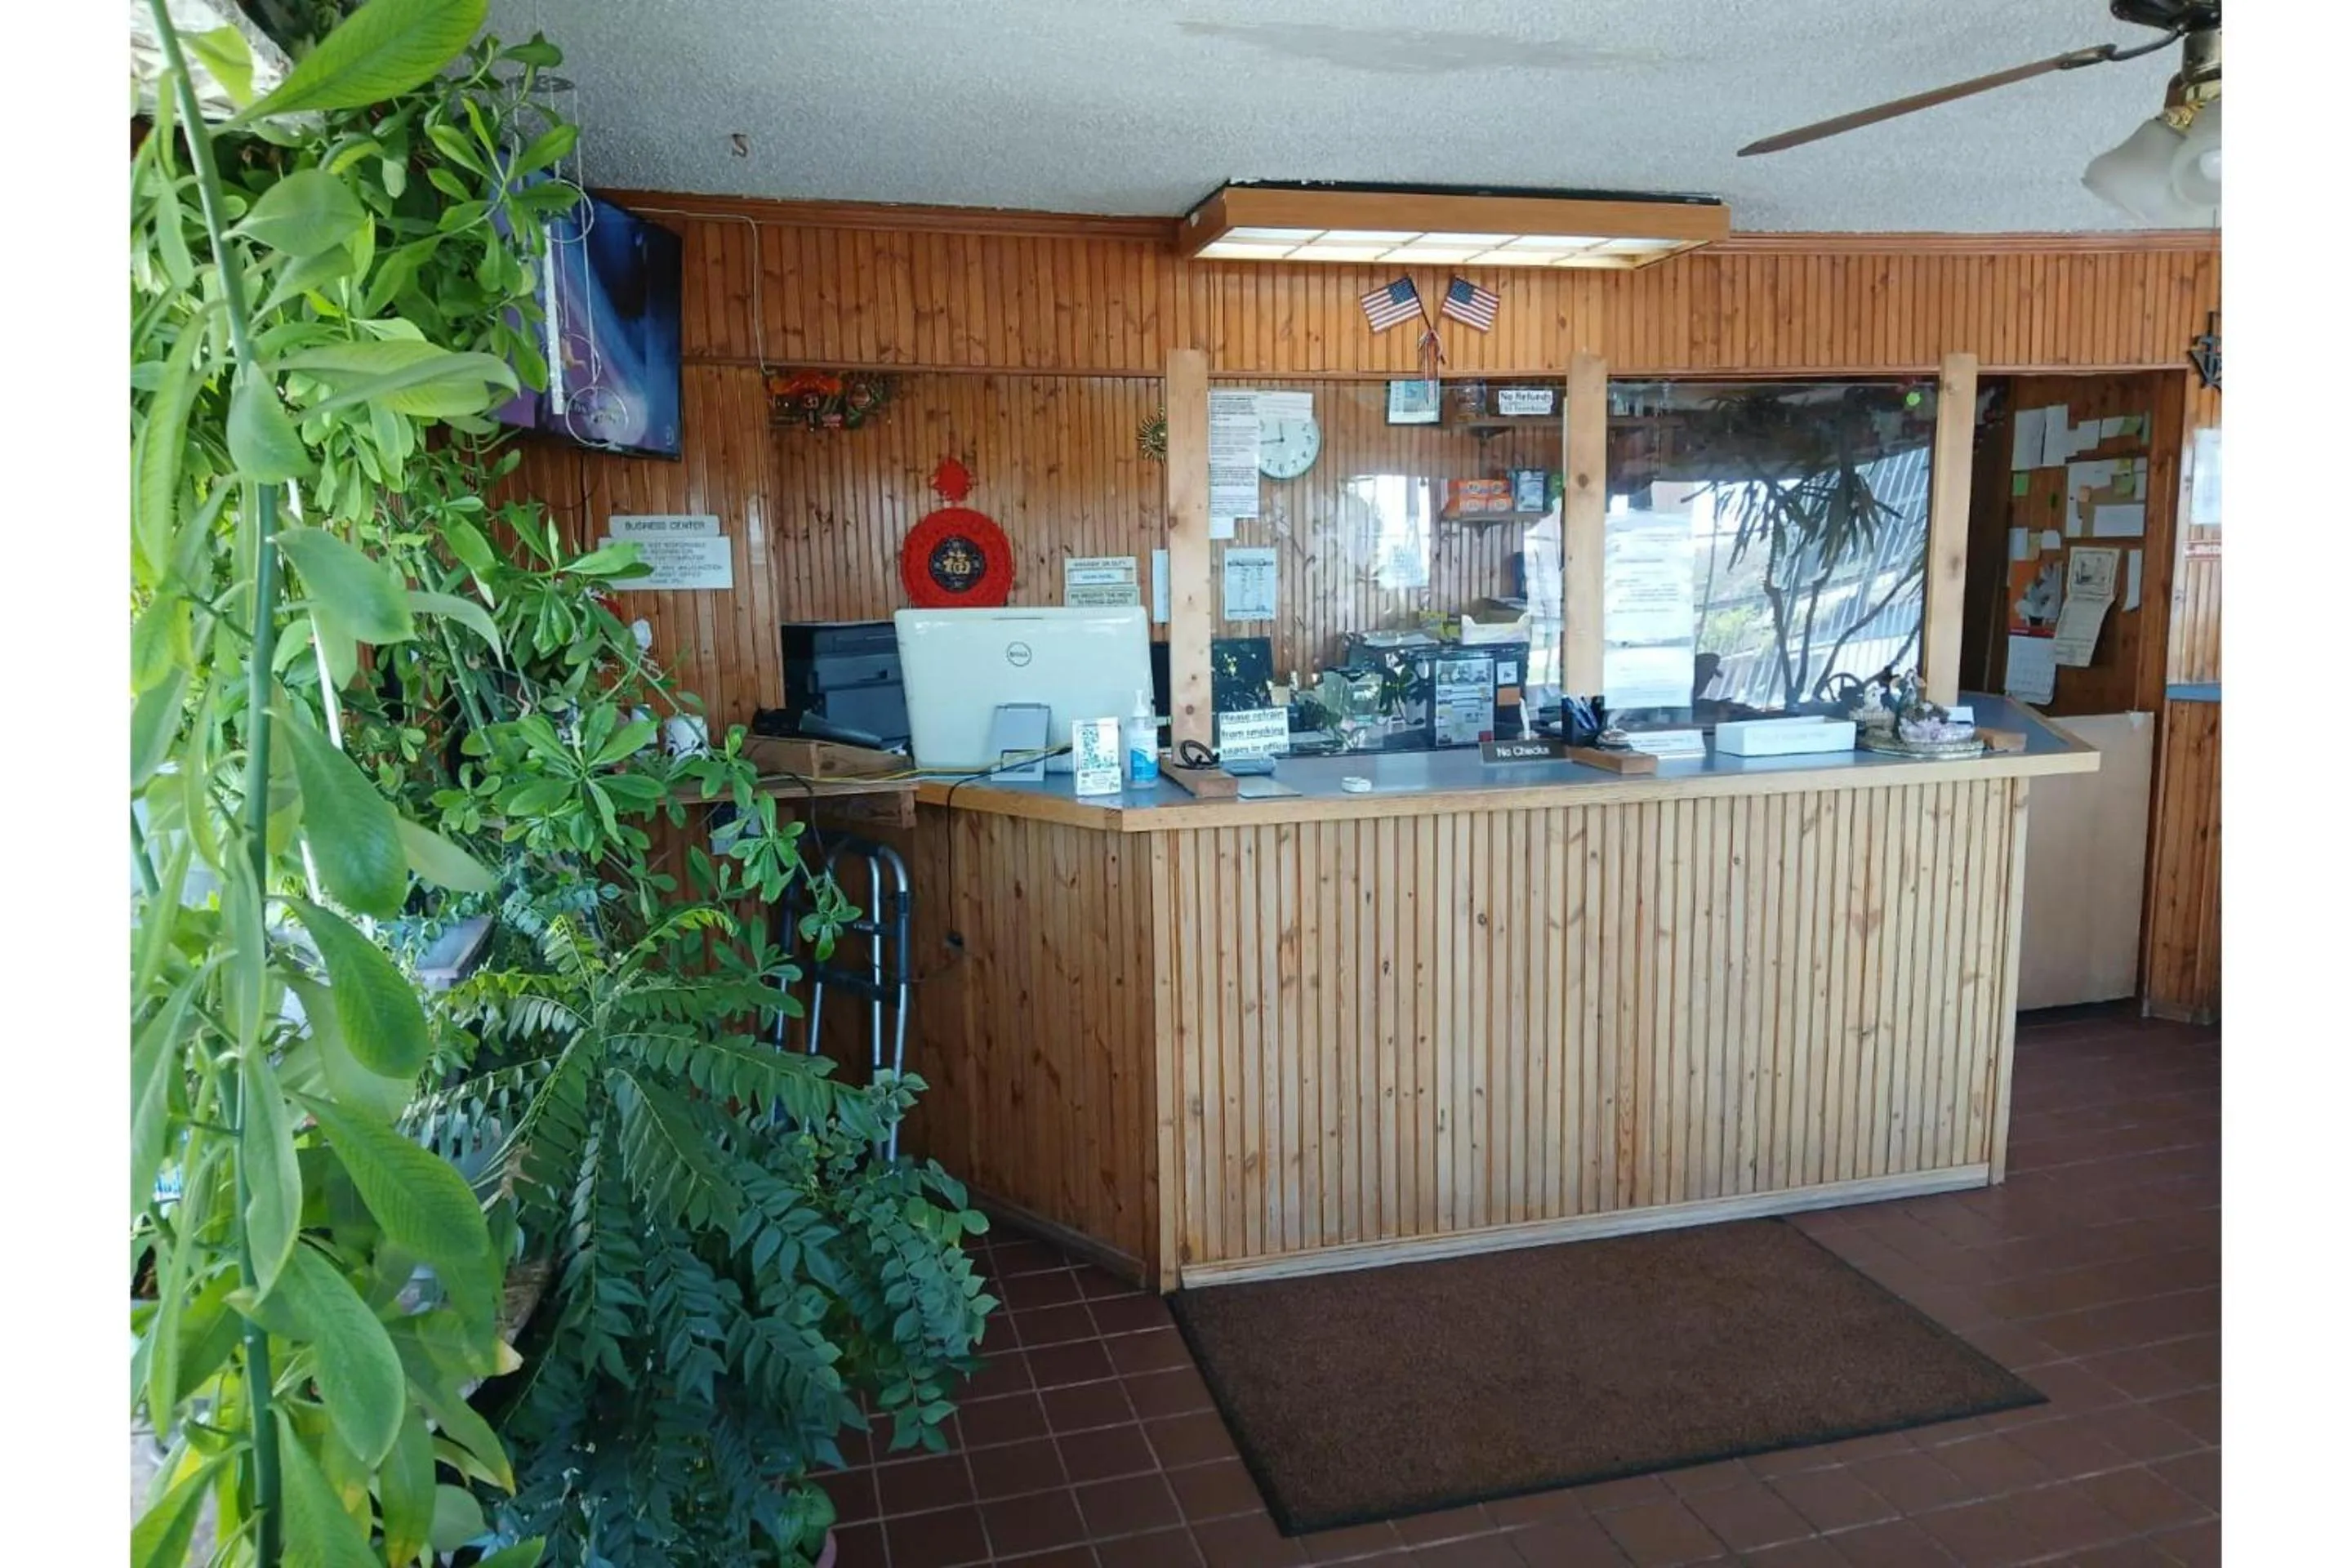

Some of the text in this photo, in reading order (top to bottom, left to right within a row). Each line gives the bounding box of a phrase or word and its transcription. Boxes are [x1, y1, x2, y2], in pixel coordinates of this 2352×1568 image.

[1500, 392, 1551, 402] No Refunds
[625, 521, 705, 531] BUSINESS CENTER
[1221, 711, 1285, 722] Please refrain
[1221, 726, 1285, 738] from smoking
[1251, 744, 1260, 752] in
[1263, 741, 1288, 751] office
[1496, 744, 1550, 757] No Checks
